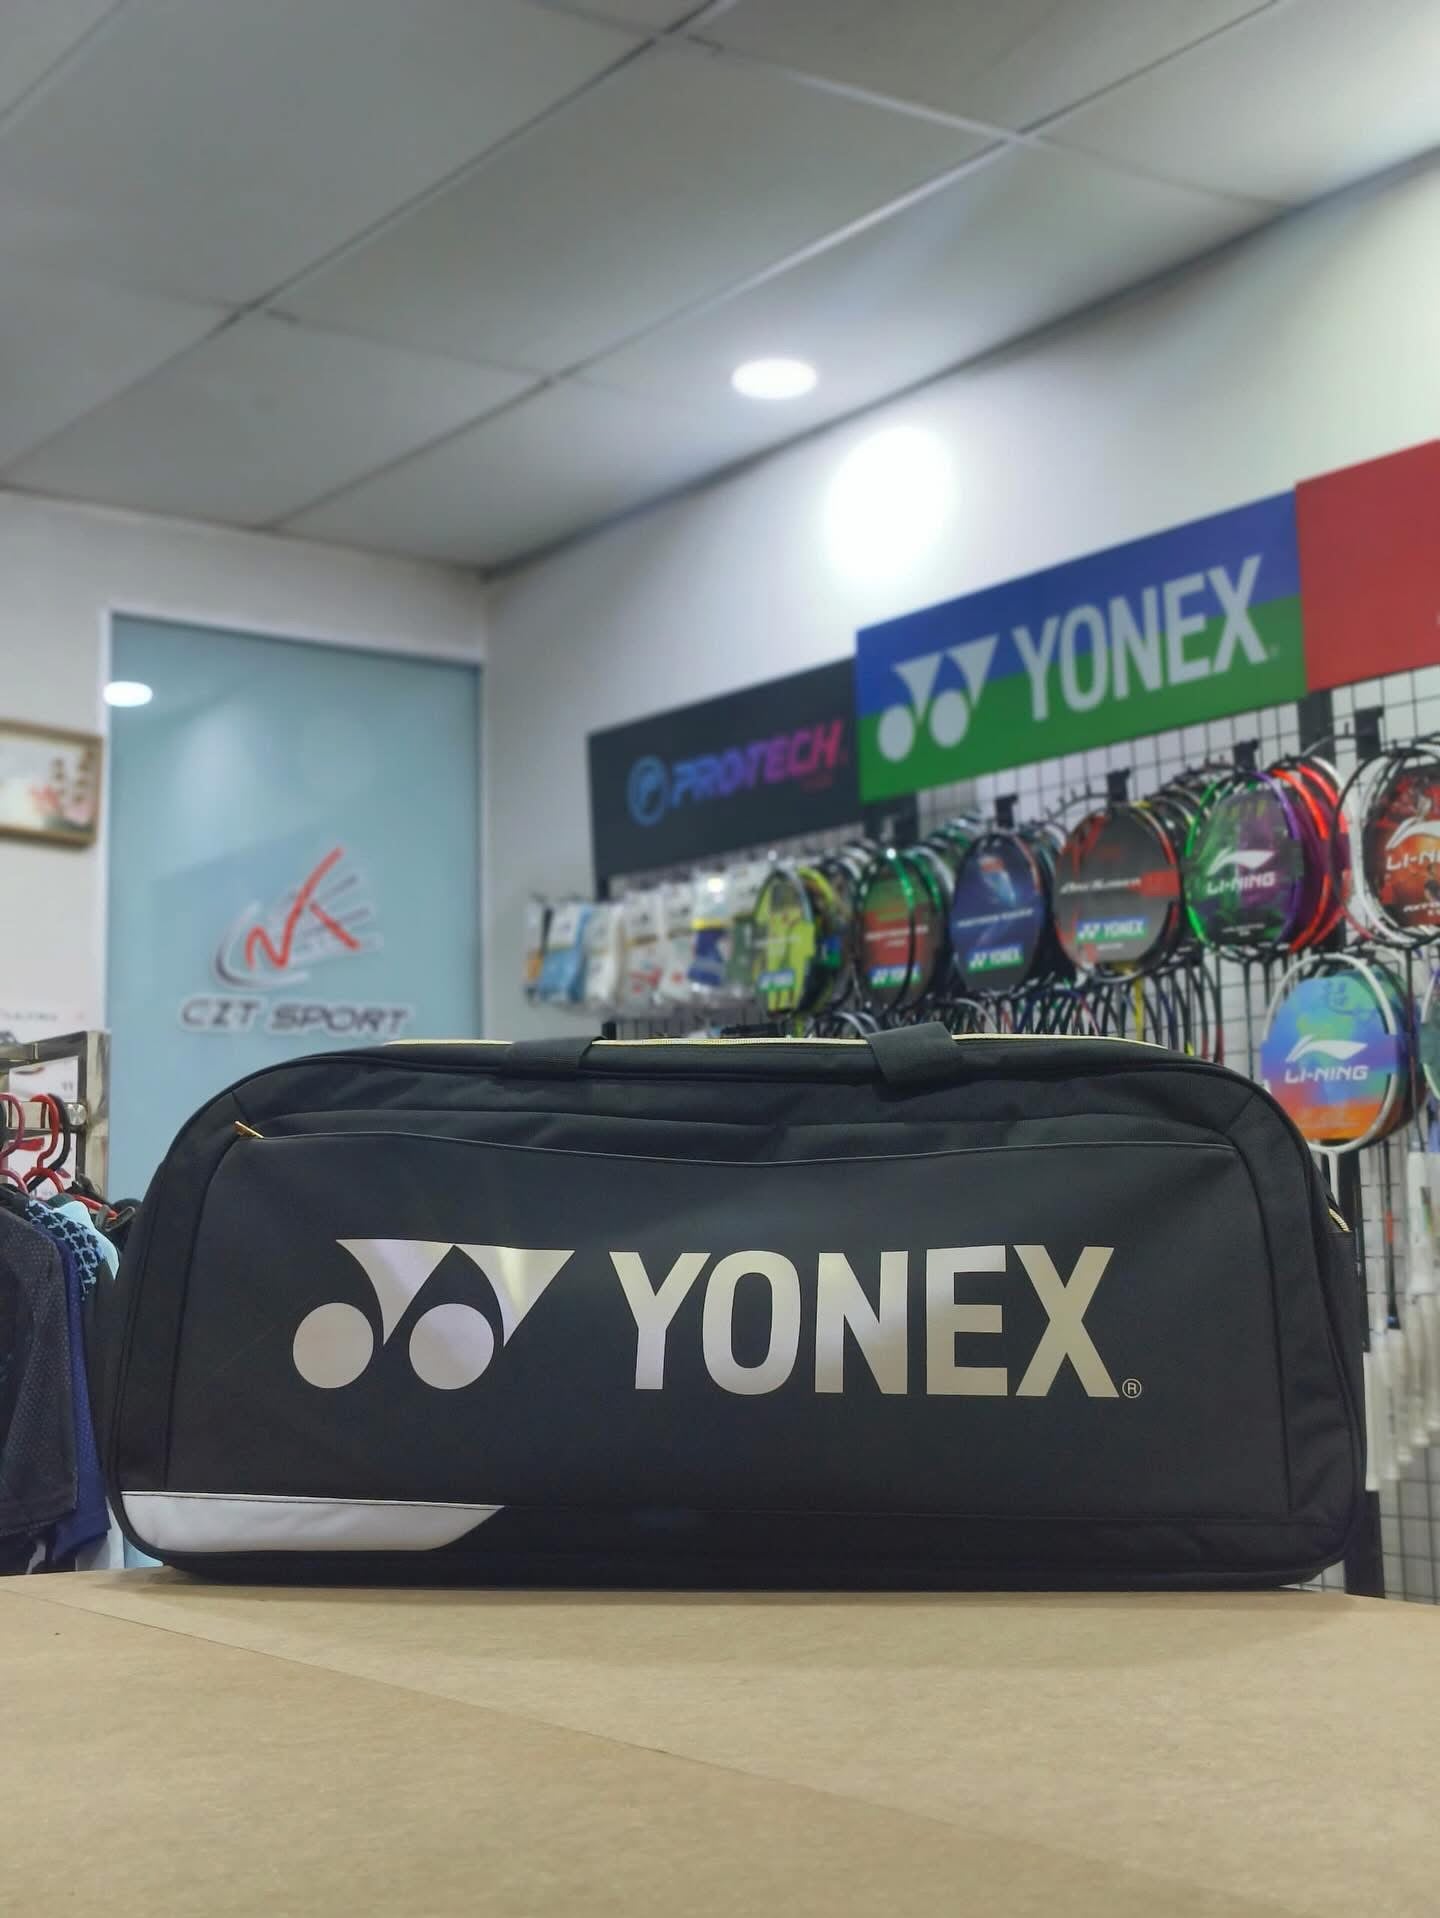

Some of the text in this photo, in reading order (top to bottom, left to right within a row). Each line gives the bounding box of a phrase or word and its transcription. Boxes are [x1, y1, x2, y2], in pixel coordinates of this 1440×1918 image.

[1011, 554, 1268, 721] YONEX
[671, 719, 843, 808] PROTECH
[1206, 871, 1276, 896] LI-NING
[271, 1002, 409, 1034] SPORT
[1284, 1065, 1369, 1084] LI-NING
[608, 1245, 1119, 1398] YONEX
